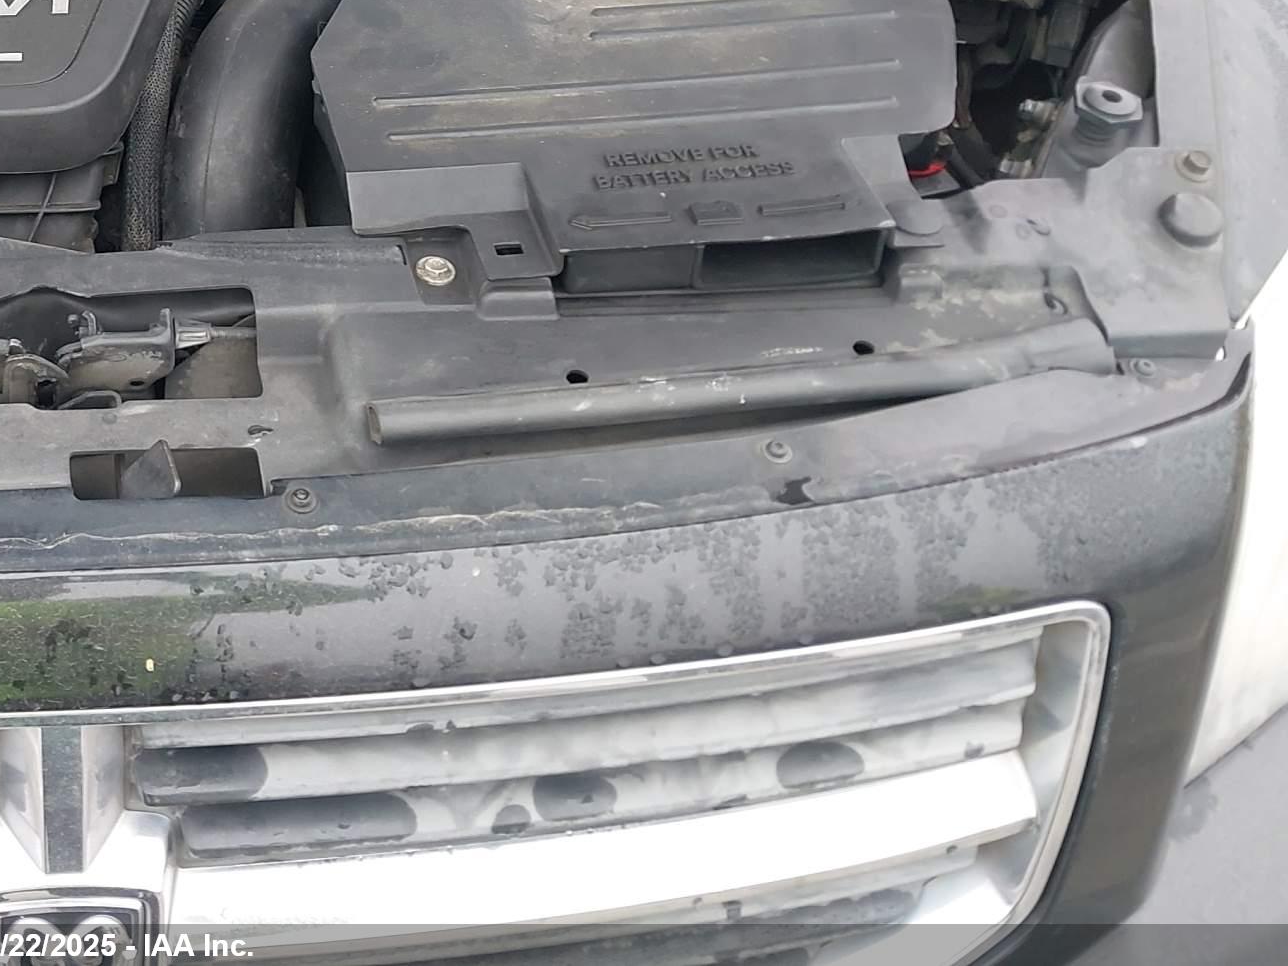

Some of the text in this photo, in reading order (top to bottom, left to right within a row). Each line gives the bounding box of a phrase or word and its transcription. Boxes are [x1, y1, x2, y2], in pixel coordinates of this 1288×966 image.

[604, 144, 759, 168] REMOVE FOR
[593, 161, 796, 190] BATTERY ACCESS
